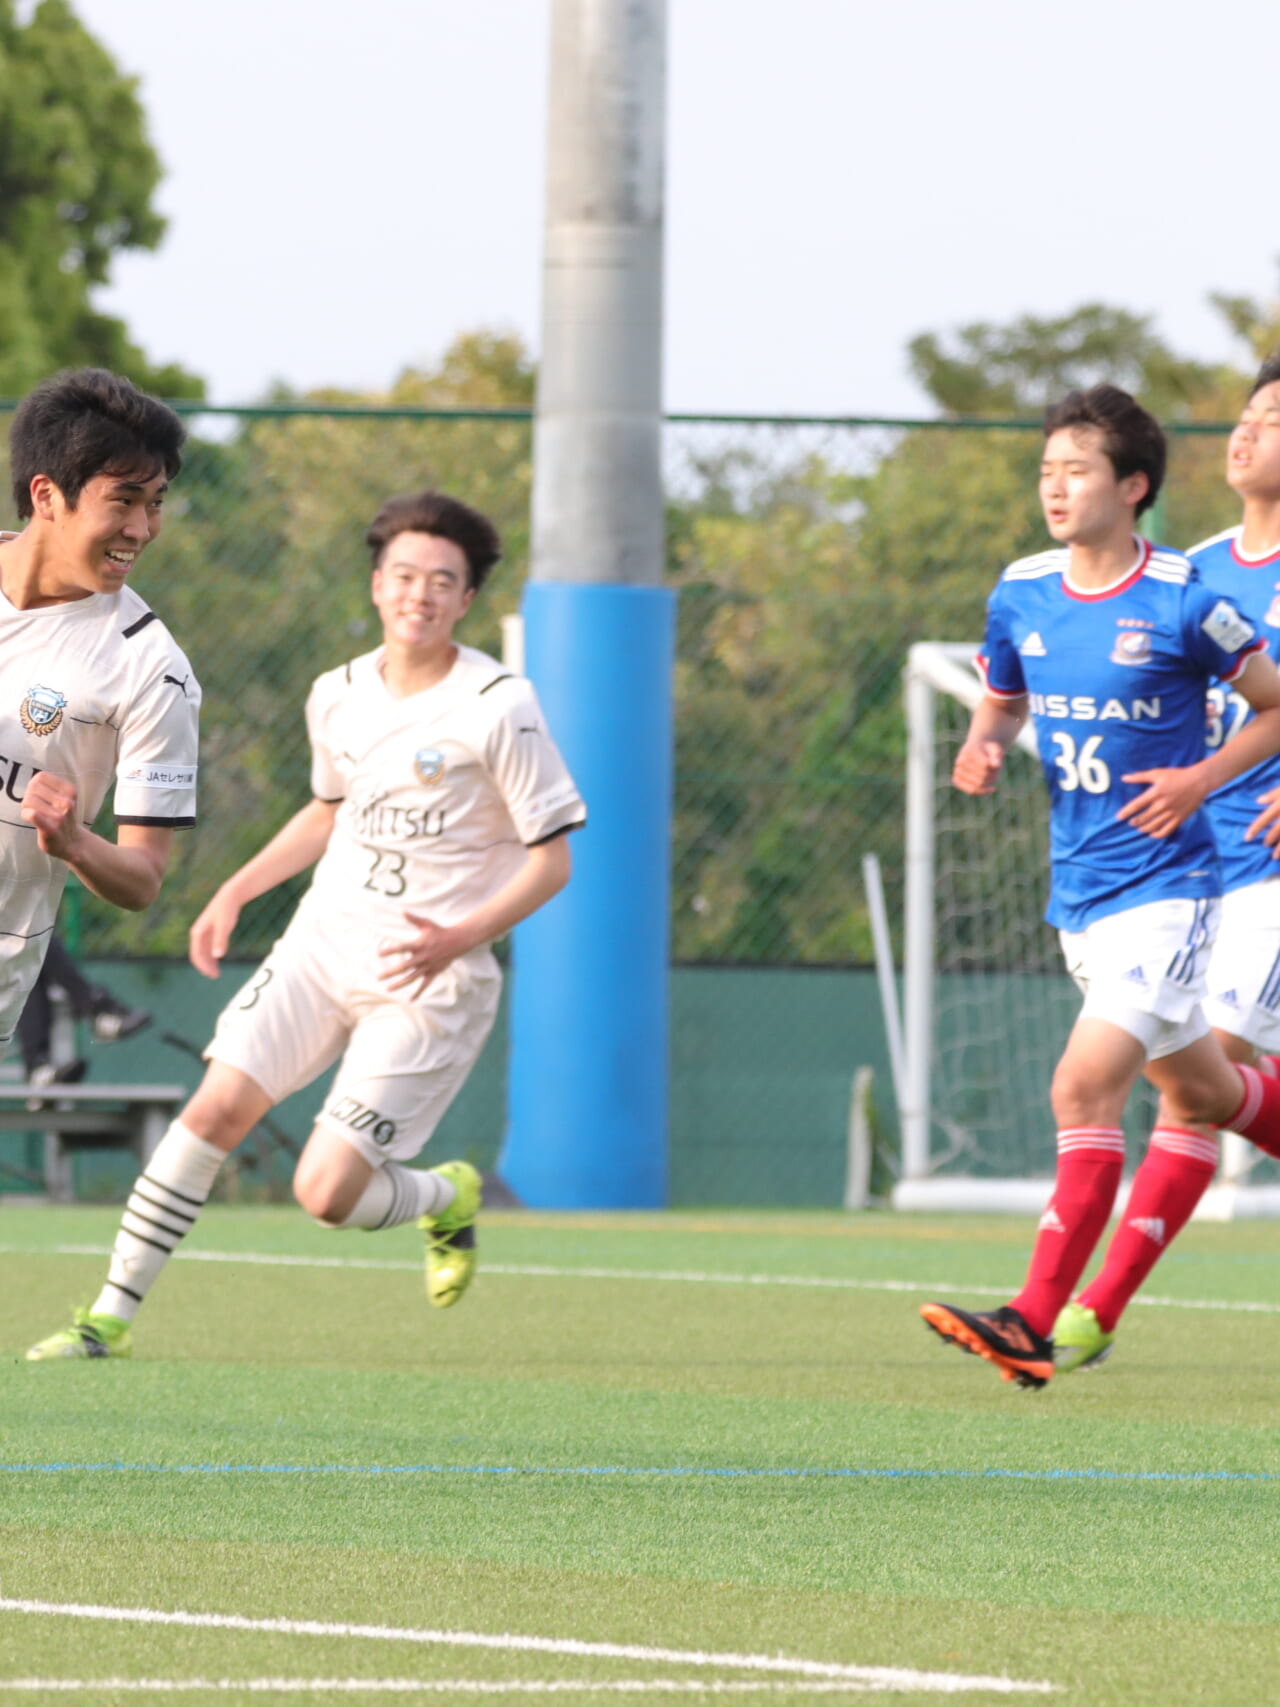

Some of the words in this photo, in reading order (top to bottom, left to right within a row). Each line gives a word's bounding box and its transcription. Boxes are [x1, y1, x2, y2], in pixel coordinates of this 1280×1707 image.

[1051, 731, 1111, 794] 36
[362, 843, 407, 897] 23
[238, 967, 274, 1011] 3
